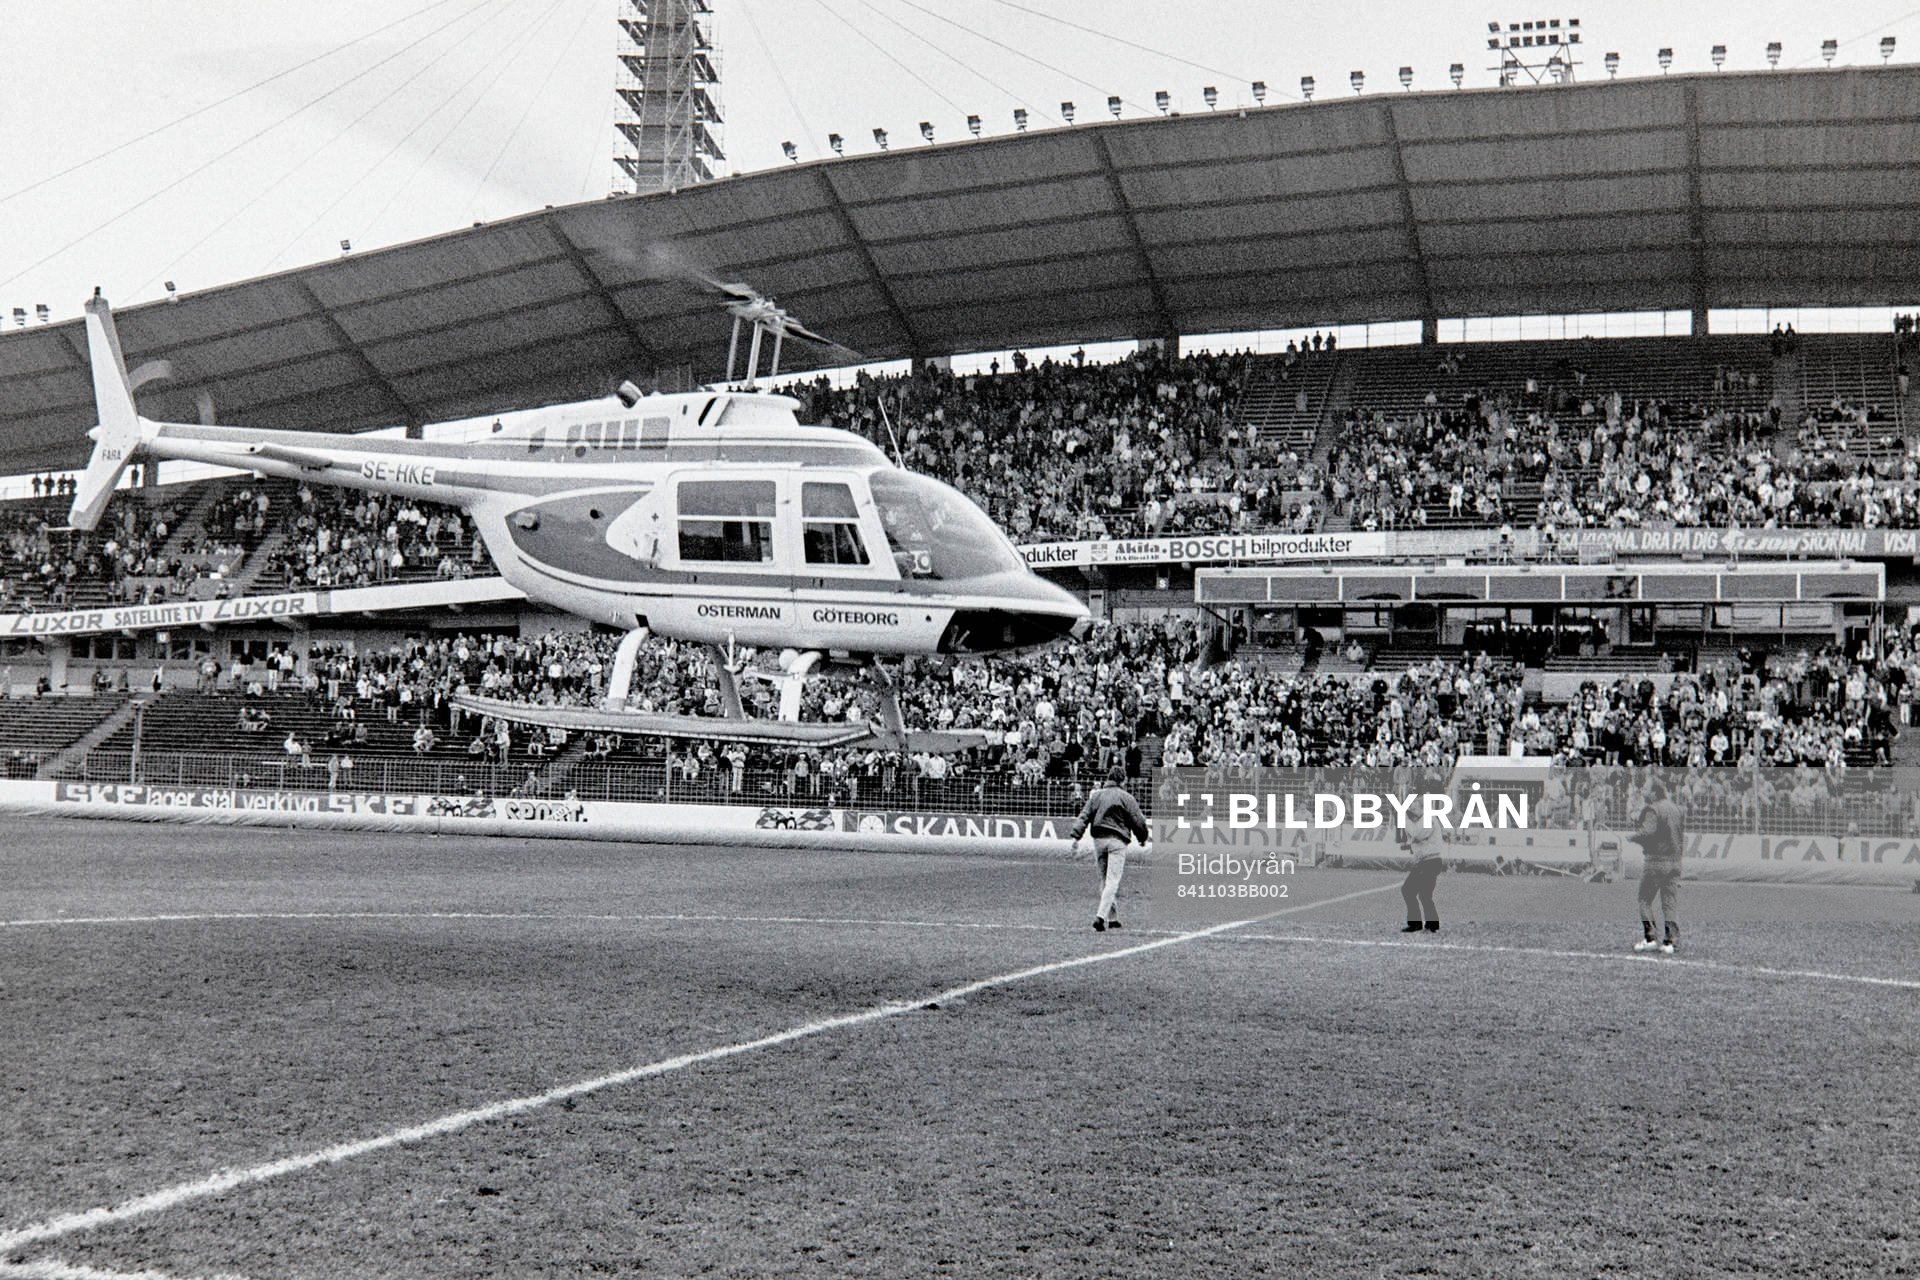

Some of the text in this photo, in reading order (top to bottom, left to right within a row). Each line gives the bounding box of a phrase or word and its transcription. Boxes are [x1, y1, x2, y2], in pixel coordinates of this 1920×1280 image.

[363, 460, 434, 485] SE-HKE
[1169, 540, 1247, 560] BOSCH
[1251, 538, 1353, 559] bilprodukter
[1641, 532, 1671, 550] DRA
[1692, 531, 1719, 550] DIG
[1884, 532, 1916, 552] VISA
[10, 598, 306, 633] LUXOR SATELLITE TV LUXOR
[697, 604, 781, 619] OSTERMAN
[812, 607, 899, 626] GÖTEBORG
[146, 787, 196, 807] lager
[202, 789, 236, 808] stål
[894, 816, 1058, 839] SKANDIA
[1150, 824, 1309, 847] KANDIA
